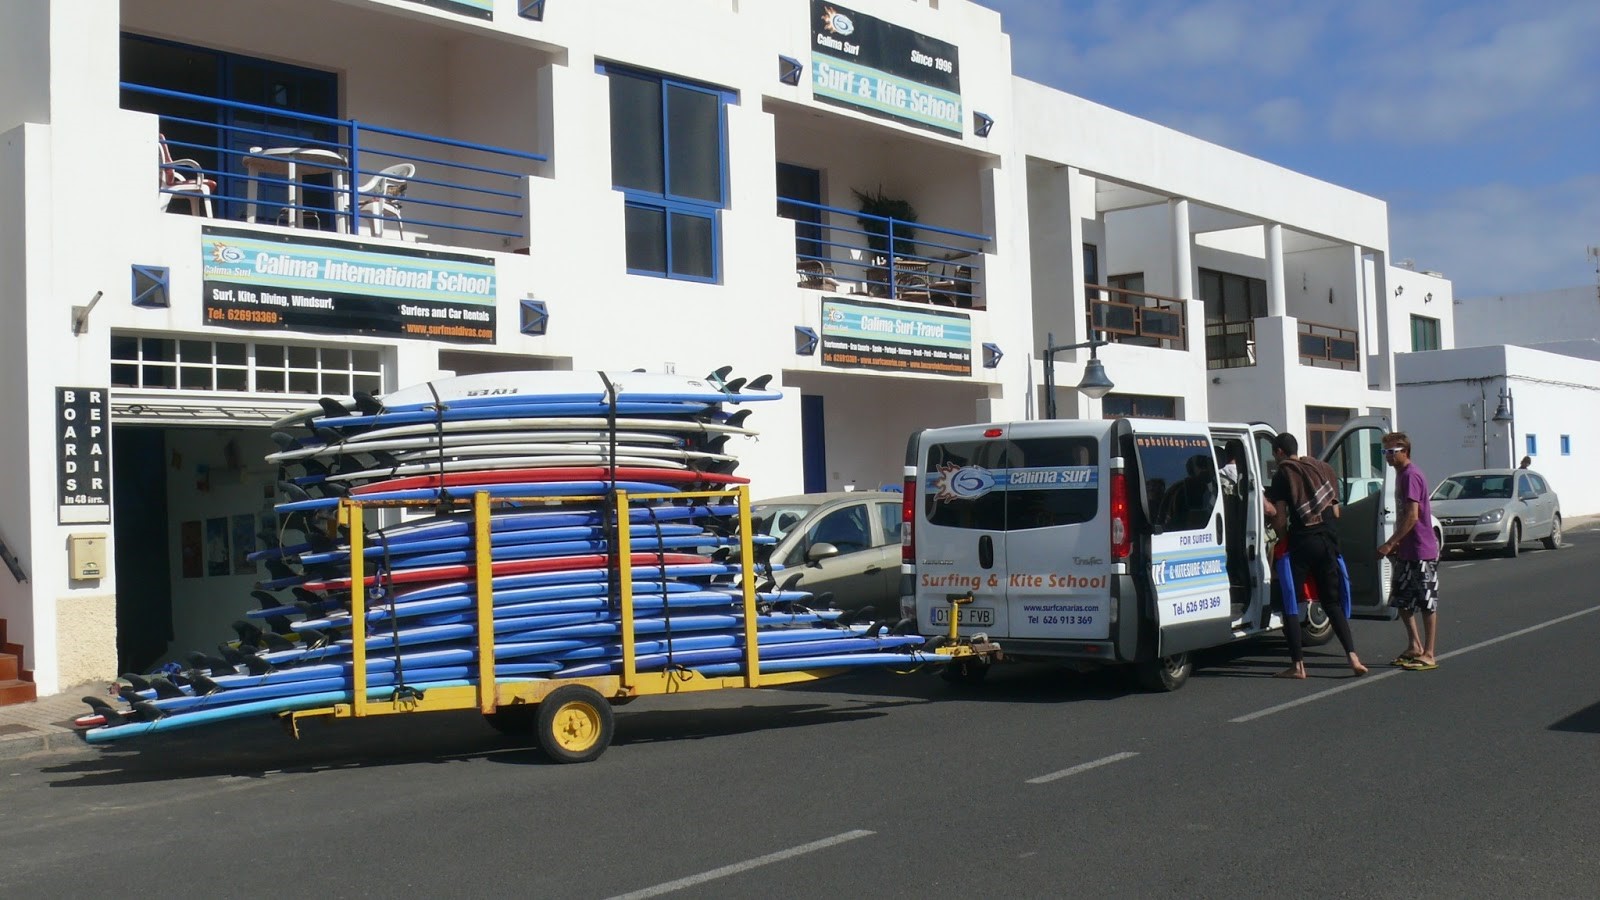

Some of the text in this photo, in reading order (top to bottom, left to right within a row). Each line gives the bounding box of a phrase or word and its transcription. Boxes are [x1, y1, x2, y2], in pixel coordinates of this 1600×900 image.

[817, 33, 860, 56] Calima Surf
[911, 50, 953, 74] Since 1996
[818, 62, 959, 124] Surf & Kite School
[204, 265, 251, 277] Calima Surf
[255, 252, 492, 295] Calima International School
[212, 289, 335, 310] Surf, Kite, Diving, Windsurf,
[208, 307, 277, 323] Tel: 626913369
[401, 304, 490, 322] Surfers and Car Rentals
[406, 323, 493, 339] www.surfmaldivas.com
[861, 315, 894, 333] Calima
[895, 320, 914, 336] Surf
[917, 321, 944, 339] Travel
[666, 364, 675, 375] 14
[64, 390, 77, 491] BOARDS
[89, 391, 104, 490] REPAIR
[1009, 468, 1092, 485] calima surf
[75, 494, 87, 504] 48
[1180, 533, 1212, 546] FOR SURFER
[1169, 565, 1175, 579] &
[1175, 562, 1200, 578] KITESURF
[1201, 559, 1222, 574] SCHOOL
[921, 573, 1107, 591] Surfing & Kite School
[1023, 604, 1099, 612] www.surfcanarias.com
[1173, 596, 1221, 616] Tel. 626 913 369
[937, 609, 990, 622] 019 FVB
[1028, 616, 1093, 625] Tel 626 913 369
